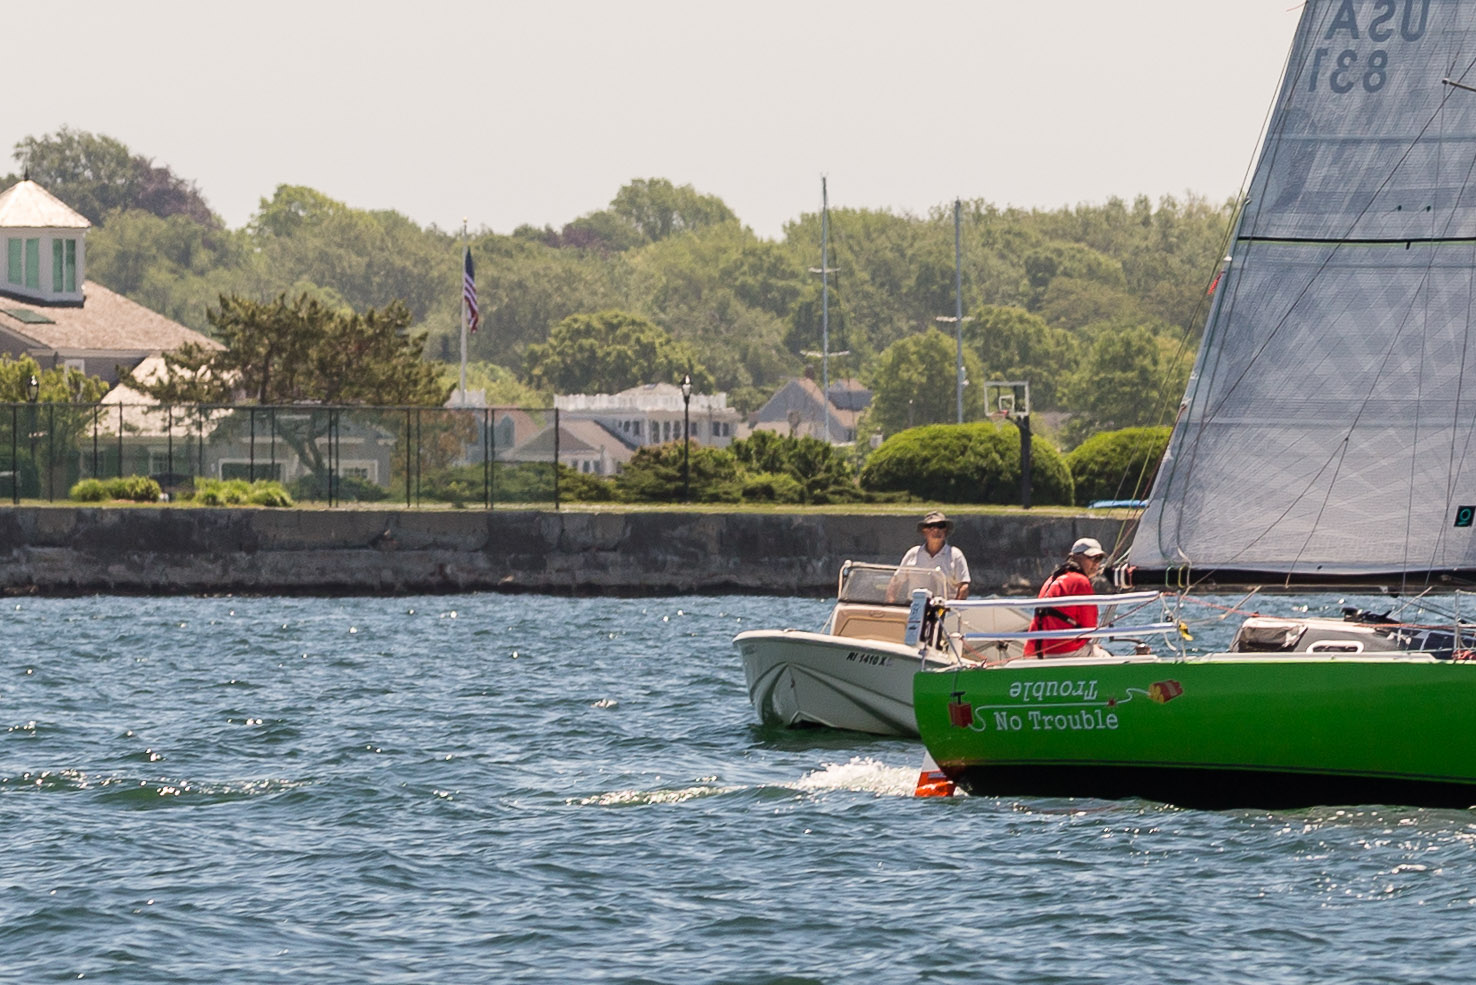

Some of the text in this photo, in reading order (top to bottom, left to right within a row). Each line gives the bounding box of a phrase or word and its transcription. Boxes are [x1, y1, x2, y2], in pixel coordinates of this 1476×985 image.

[1009, 680, 1098, 702] Trouble
[993, 709, 1119, 731] No Trouble
